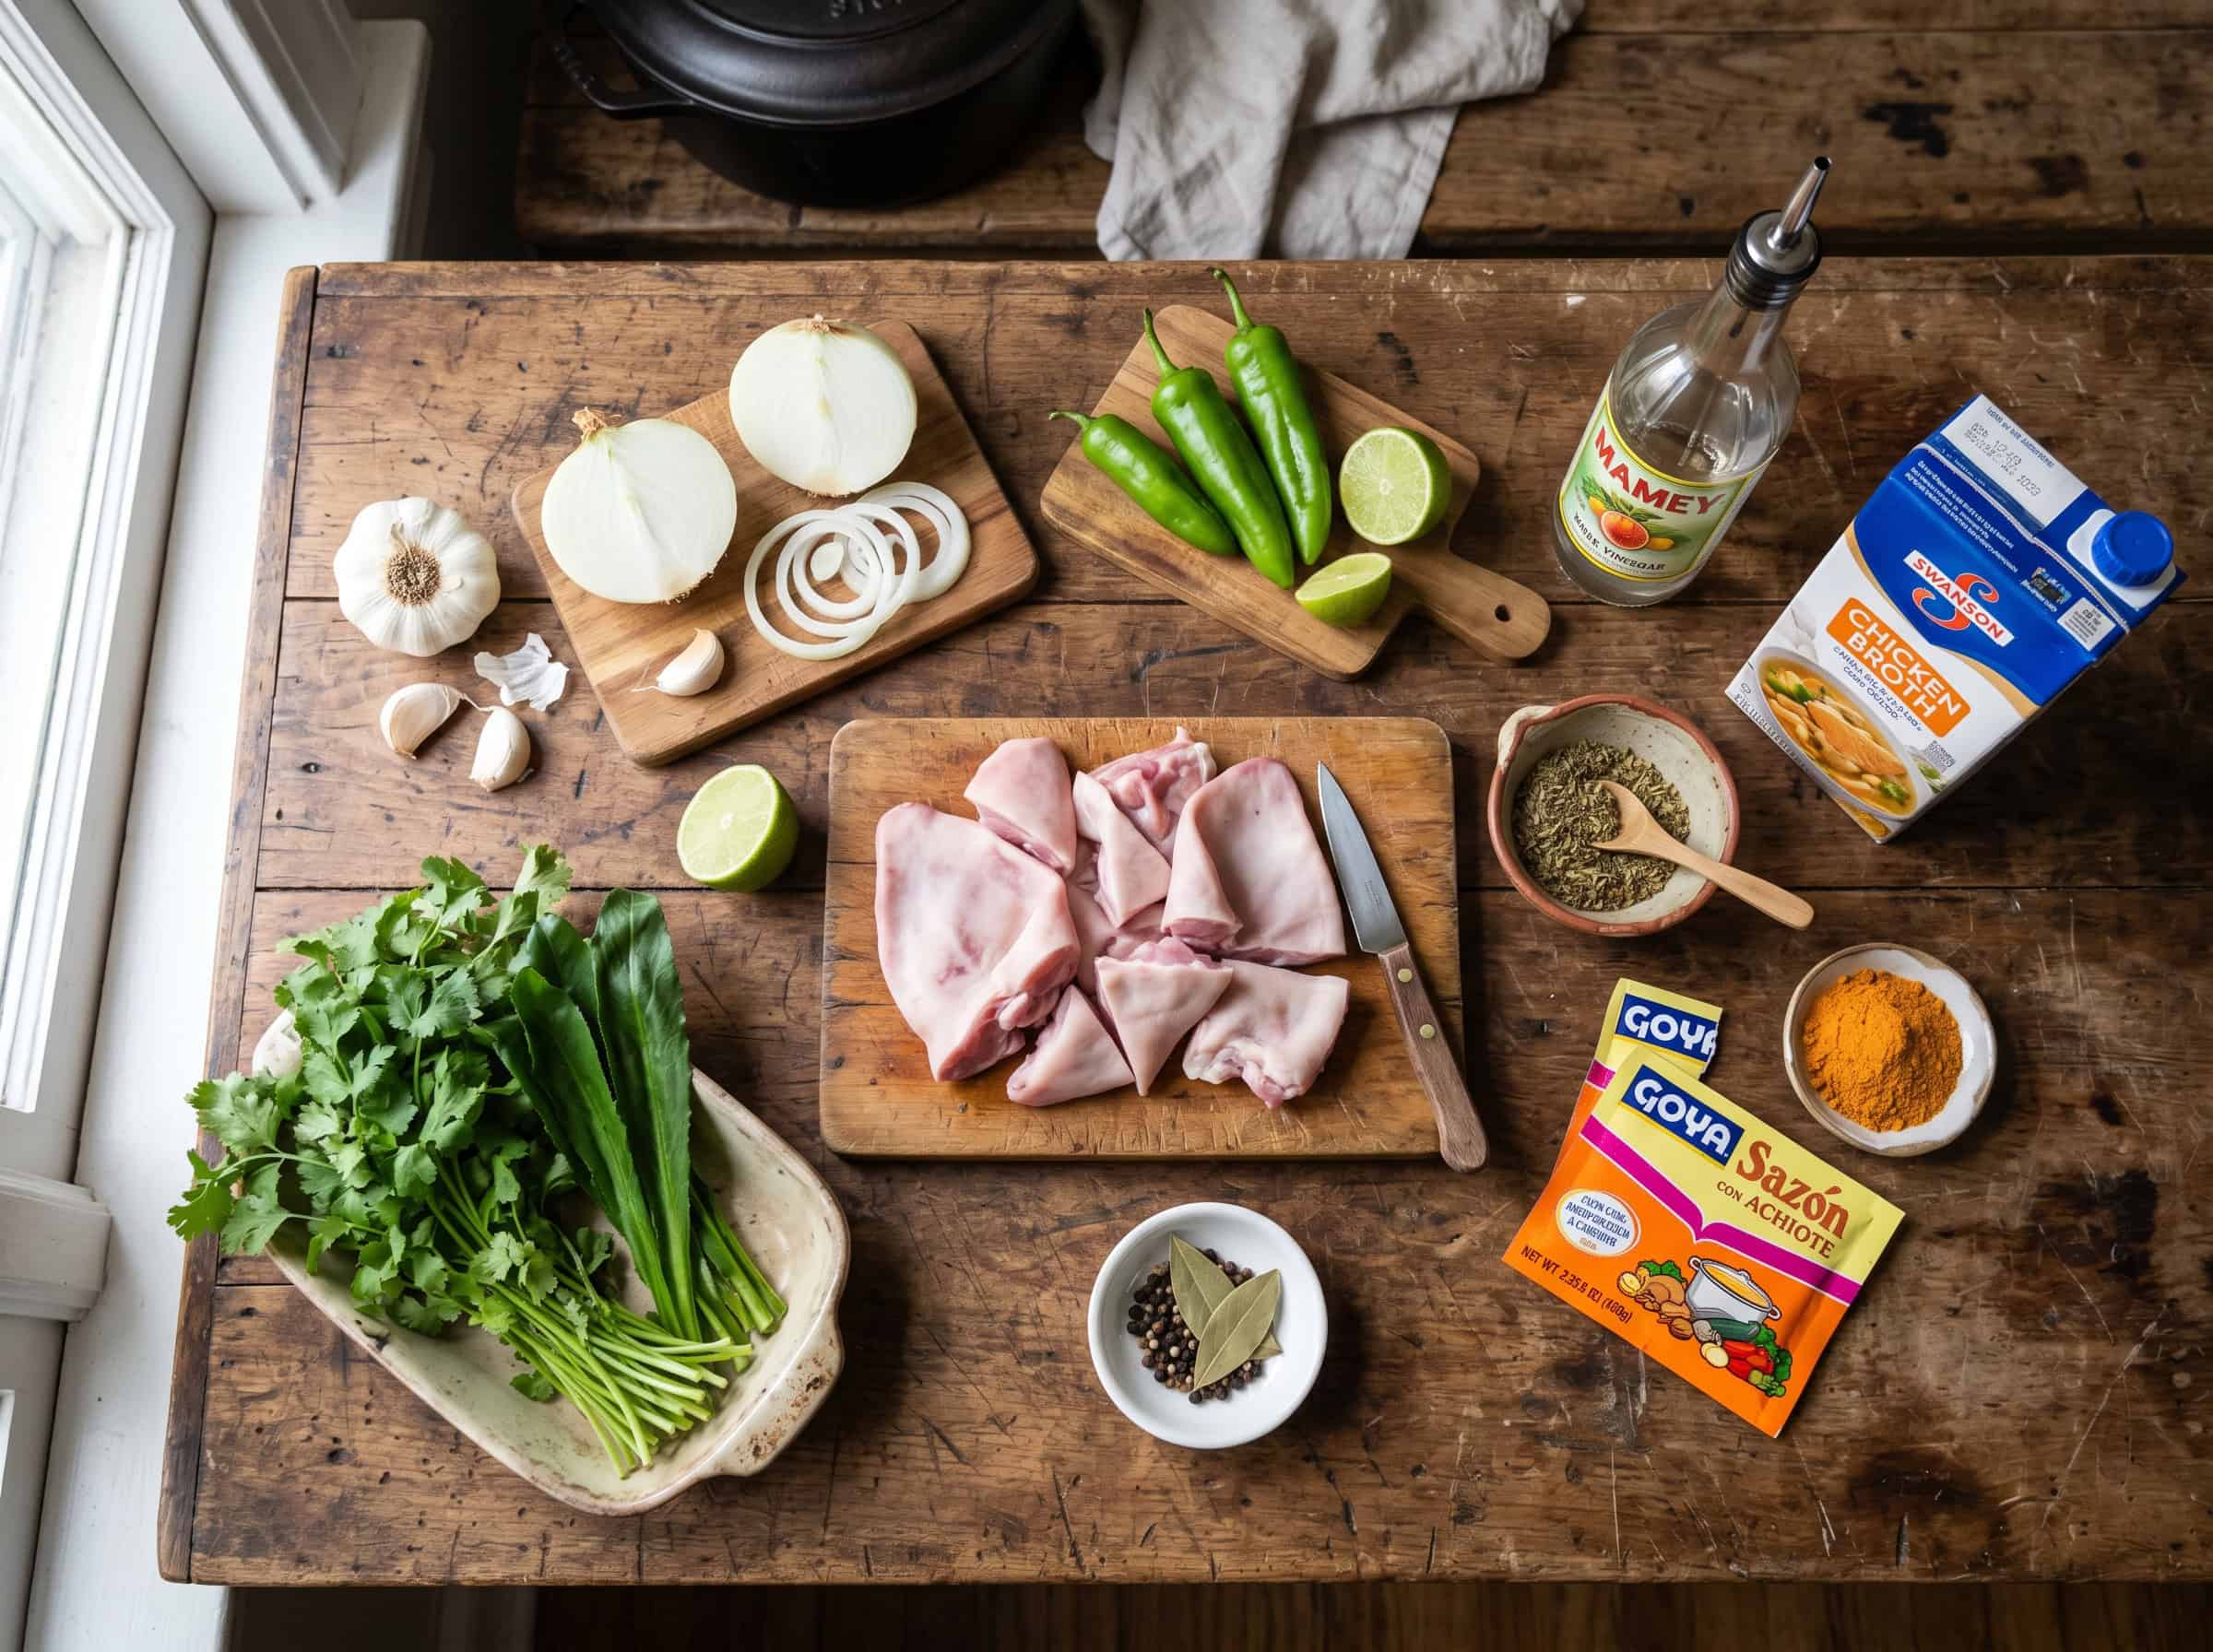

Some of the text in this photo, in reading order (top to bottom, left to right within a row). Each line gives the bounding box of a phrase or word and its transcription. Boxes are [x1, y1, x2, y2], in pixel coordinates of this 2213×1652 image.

[1595, 425, 1726, 514] MAMEY
[1913, 557, 2005, 639] SWANSON
[1846, 631, 1937, 719] BROTH
[1848, 608, 1961, 716] CHICKEN
[1634, 1079, 1732, 1156] GOYA
[1717, 1181, 1836, 1258] CON ACHIOTE
[1736, 1140, 1849, 1240] Sazón
[1521, 1245, 1543, 1264] NET
[1541, 1257, 1560, 1275] WT
